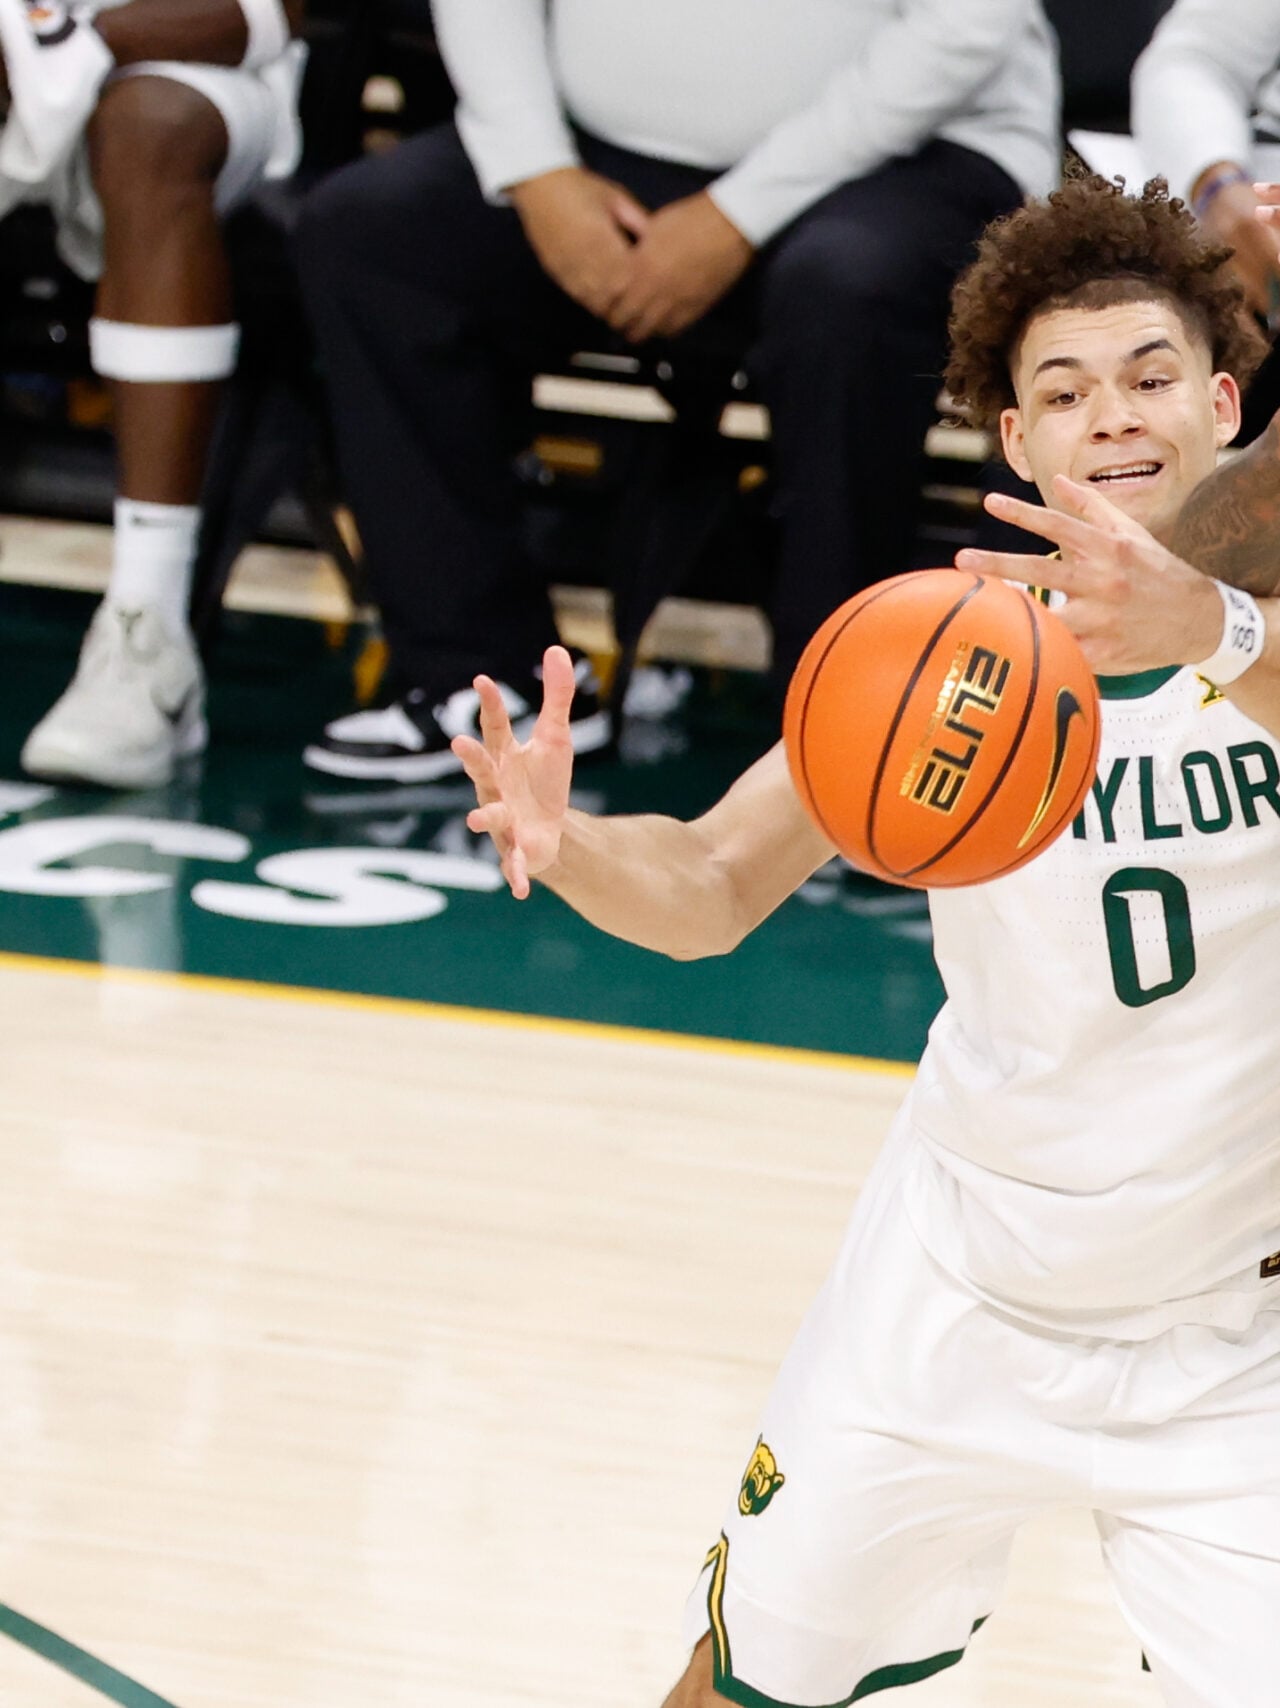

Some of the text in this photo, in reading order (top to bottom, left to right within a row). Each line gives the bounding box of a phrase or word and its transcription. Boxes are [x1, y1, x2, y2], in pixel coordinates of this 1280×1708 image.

[911, 645, 1012, 815] ELITE
[0, 780, 503, 926] CS
[1101, 867, 1196, 1008] 0
